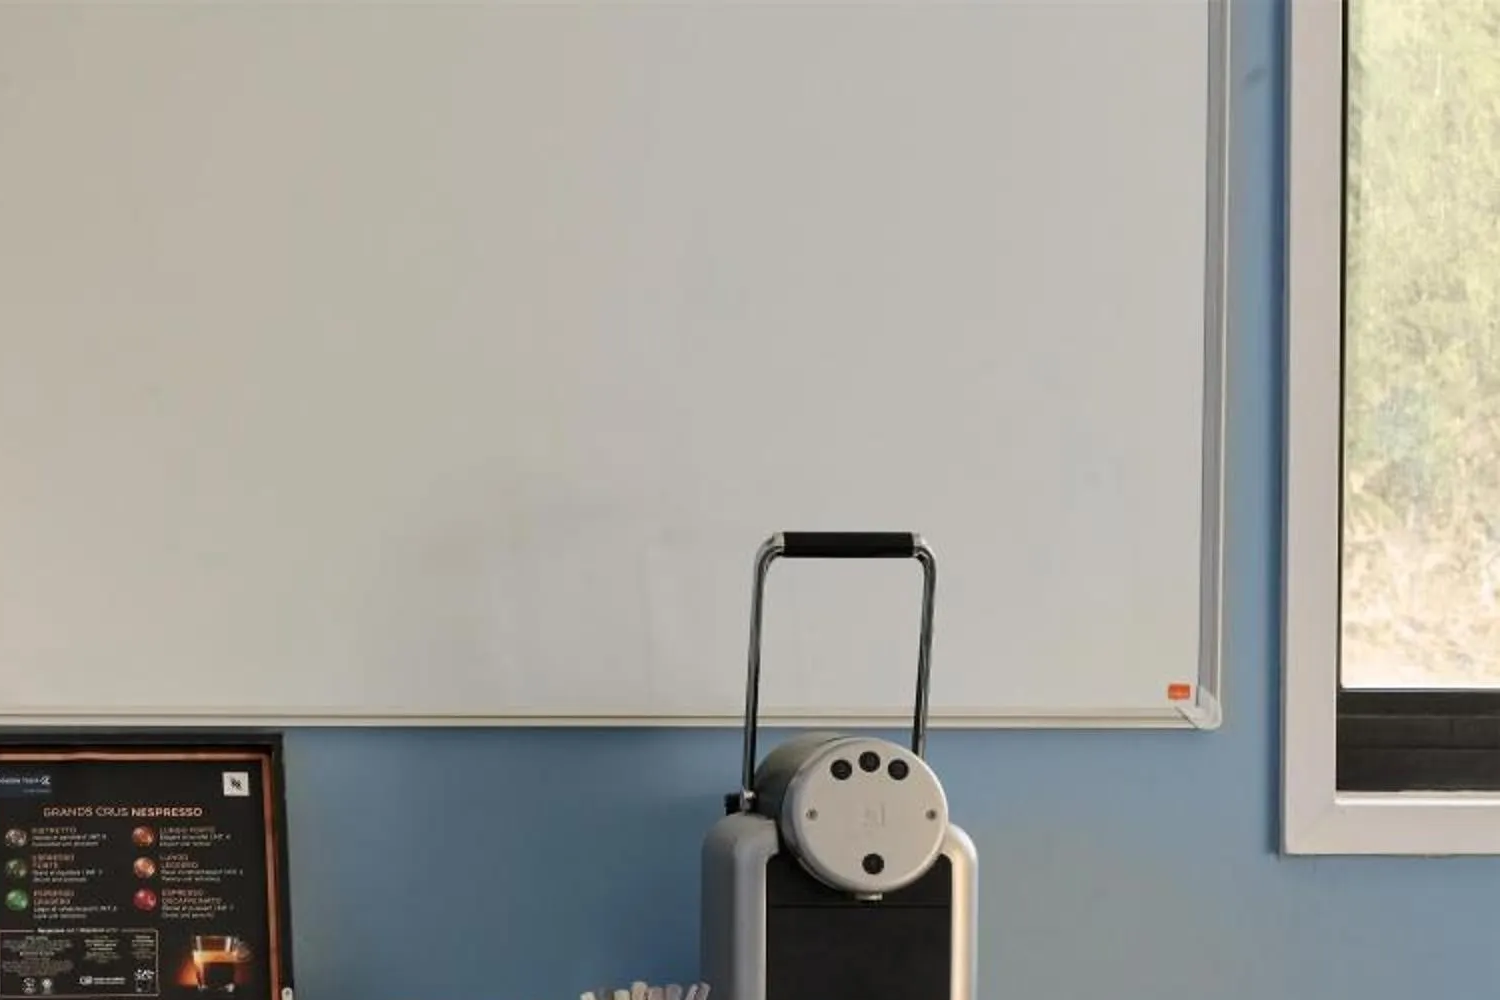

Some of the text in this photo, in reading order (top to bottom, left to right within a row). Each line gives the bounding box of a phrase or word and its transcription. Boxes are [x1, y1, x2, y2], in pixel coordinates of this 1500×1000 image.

[43, 807, 203, 817] GRANDS CRUS NESPRESSO
